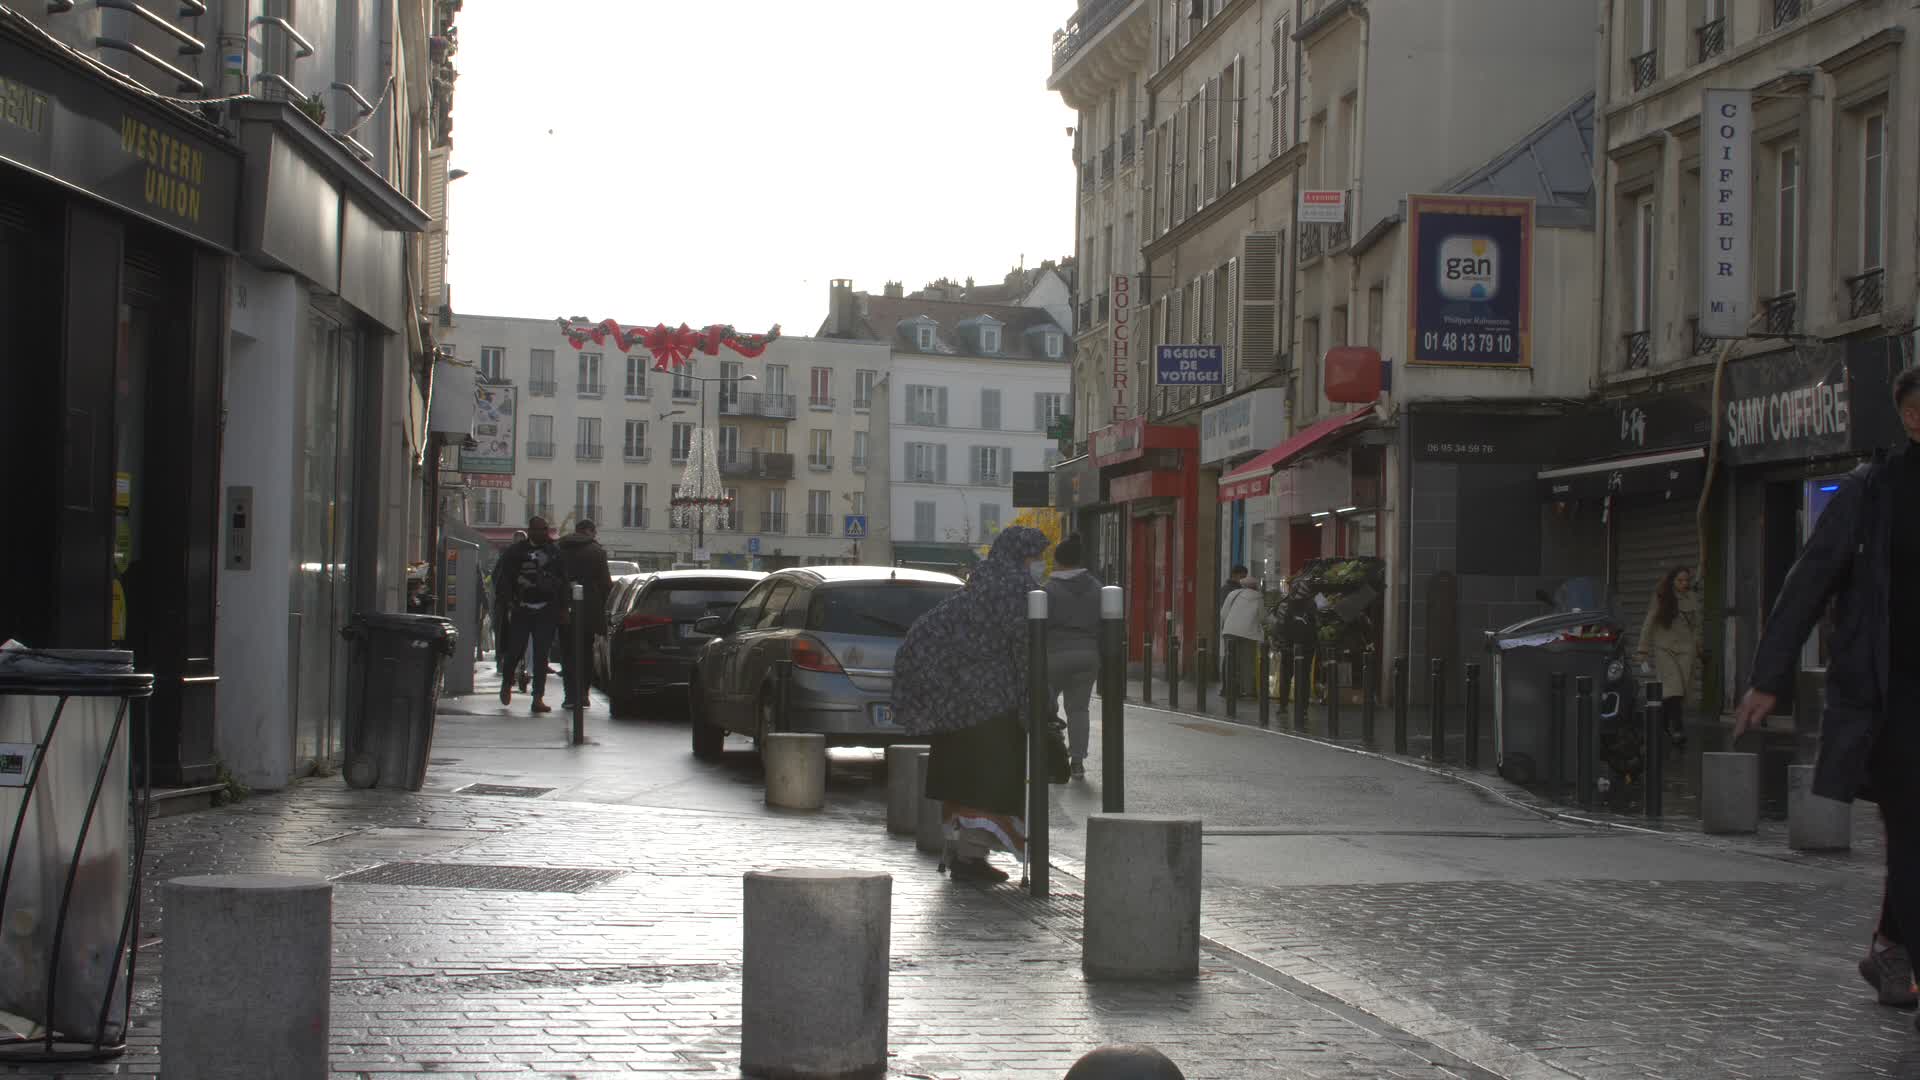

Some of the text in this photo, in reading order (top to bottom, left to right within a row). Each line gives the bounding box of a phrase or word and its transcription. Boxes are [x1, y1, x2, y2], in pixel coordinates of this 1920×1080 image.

[121, 112, 204, 185] WESTERN
[145, 167, 200, 223] UNION
[1718, 103, 1737, 277] COIFFEUR
[1446, 256, 1490, 280] gan
[1112, 275, 1129, 422] BOUCHERIE
[1163, 348, 1217, 359] AGENCE
[1424, 332, 1512, 353] 01 48 13 79 10
[1161, 371, 1219, 381] VOYAGES
[1179, 360, 1198, 370] DE
[1728, 383, 1849, 448] SAMY COIFFURE
